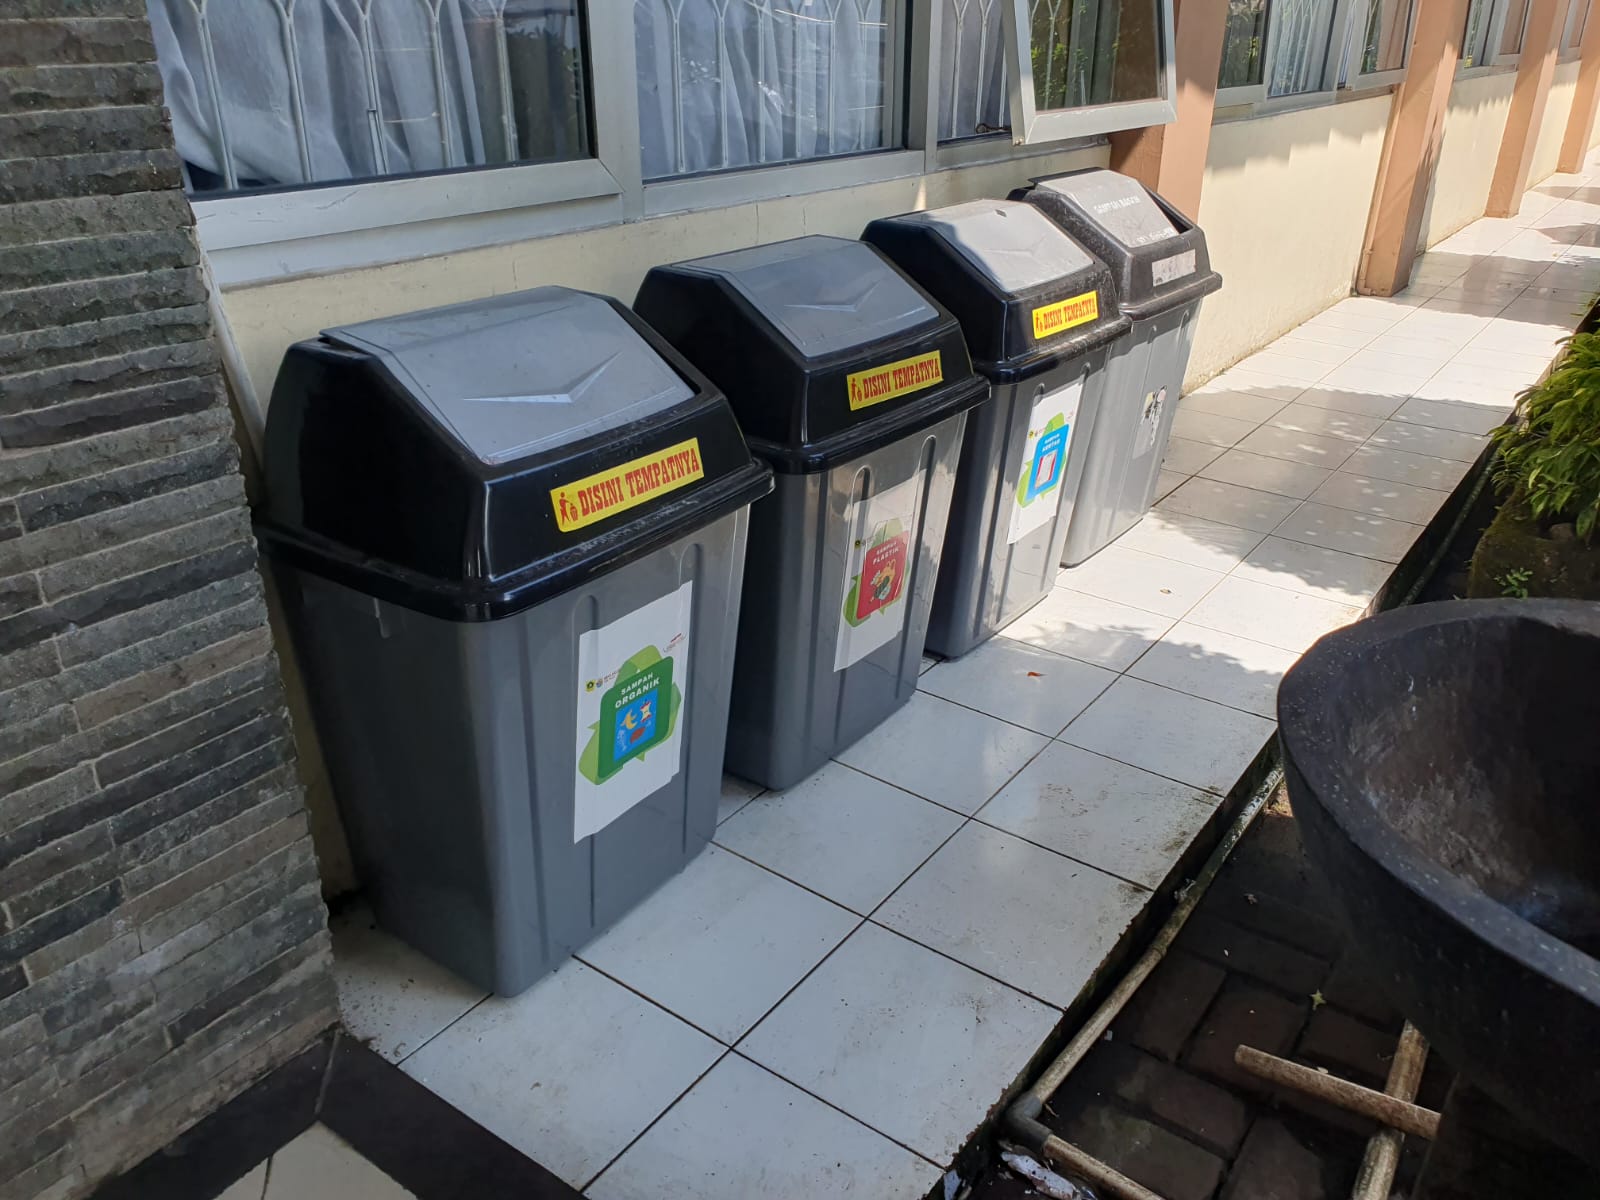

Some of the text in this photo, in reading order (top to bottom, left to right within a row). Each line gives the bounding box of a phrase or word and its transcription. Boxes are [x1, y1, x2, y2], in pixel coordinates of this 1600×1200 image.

[862, 358, 941, 399] DISINI TEMPATNYA
[577, 447, 700, 516] DISINI TEMPATNYA
[615, 677, 660, 708] ORGANIK
[621, 672, 653, 695] SAMPAH
